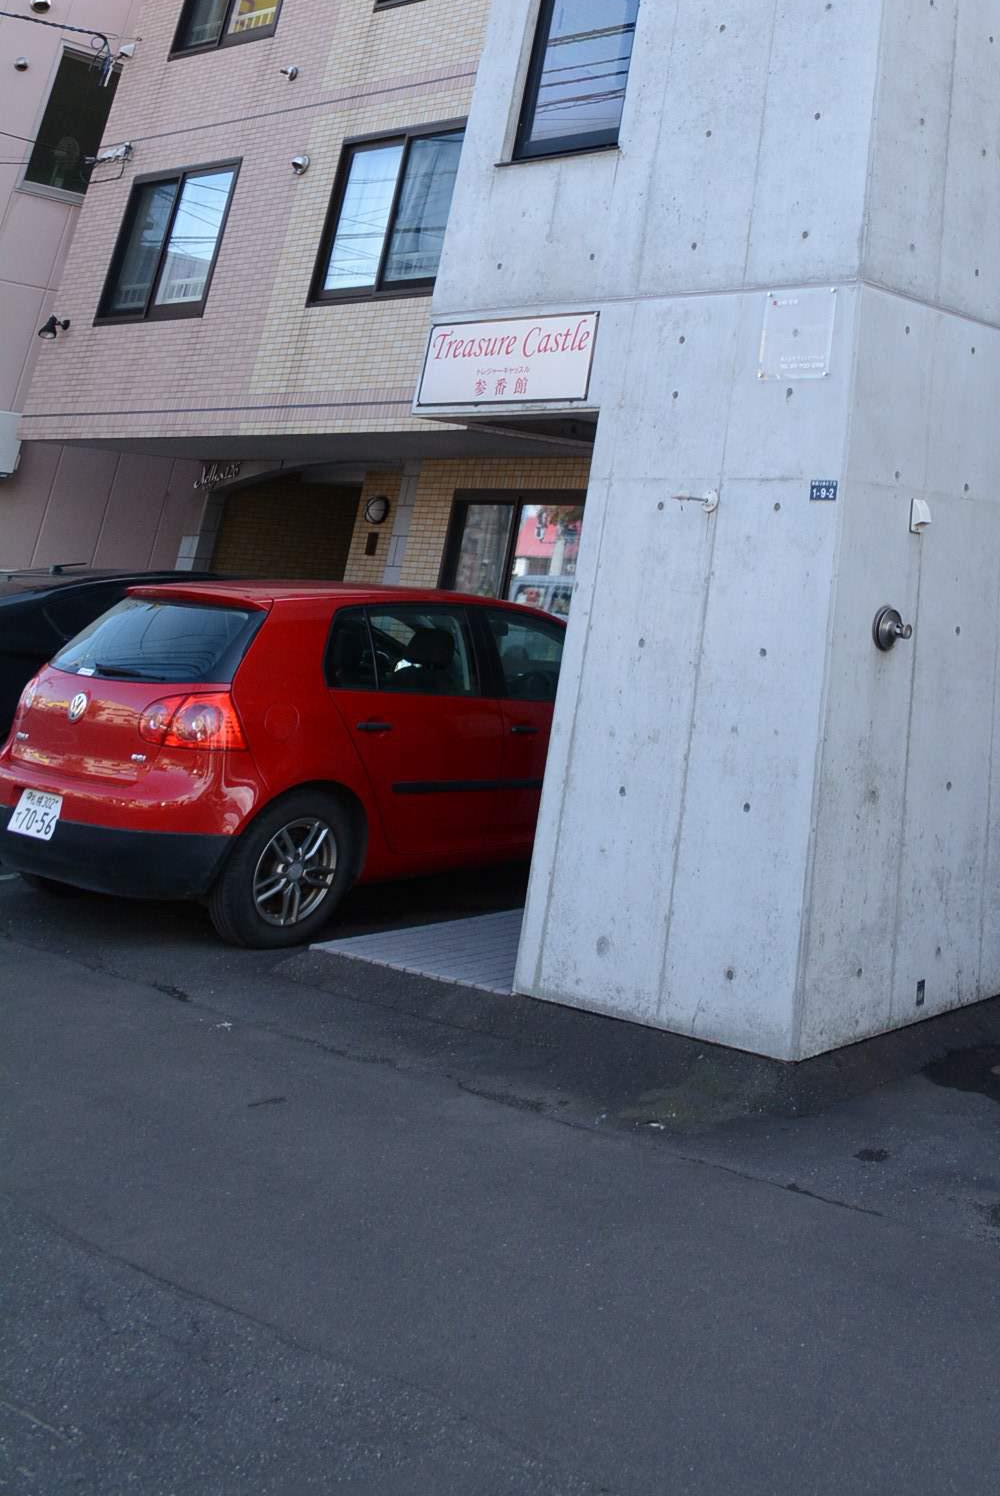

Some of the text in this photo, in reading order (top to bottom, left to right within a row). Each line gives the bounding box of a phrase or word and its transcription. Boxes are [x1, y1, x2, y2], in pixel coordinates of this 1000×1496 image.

[433, 318, 591, 360] Treasure Castle
[812, 487, 834, 499] 1-9-2
[18, 807, 57, 835] 70-56
